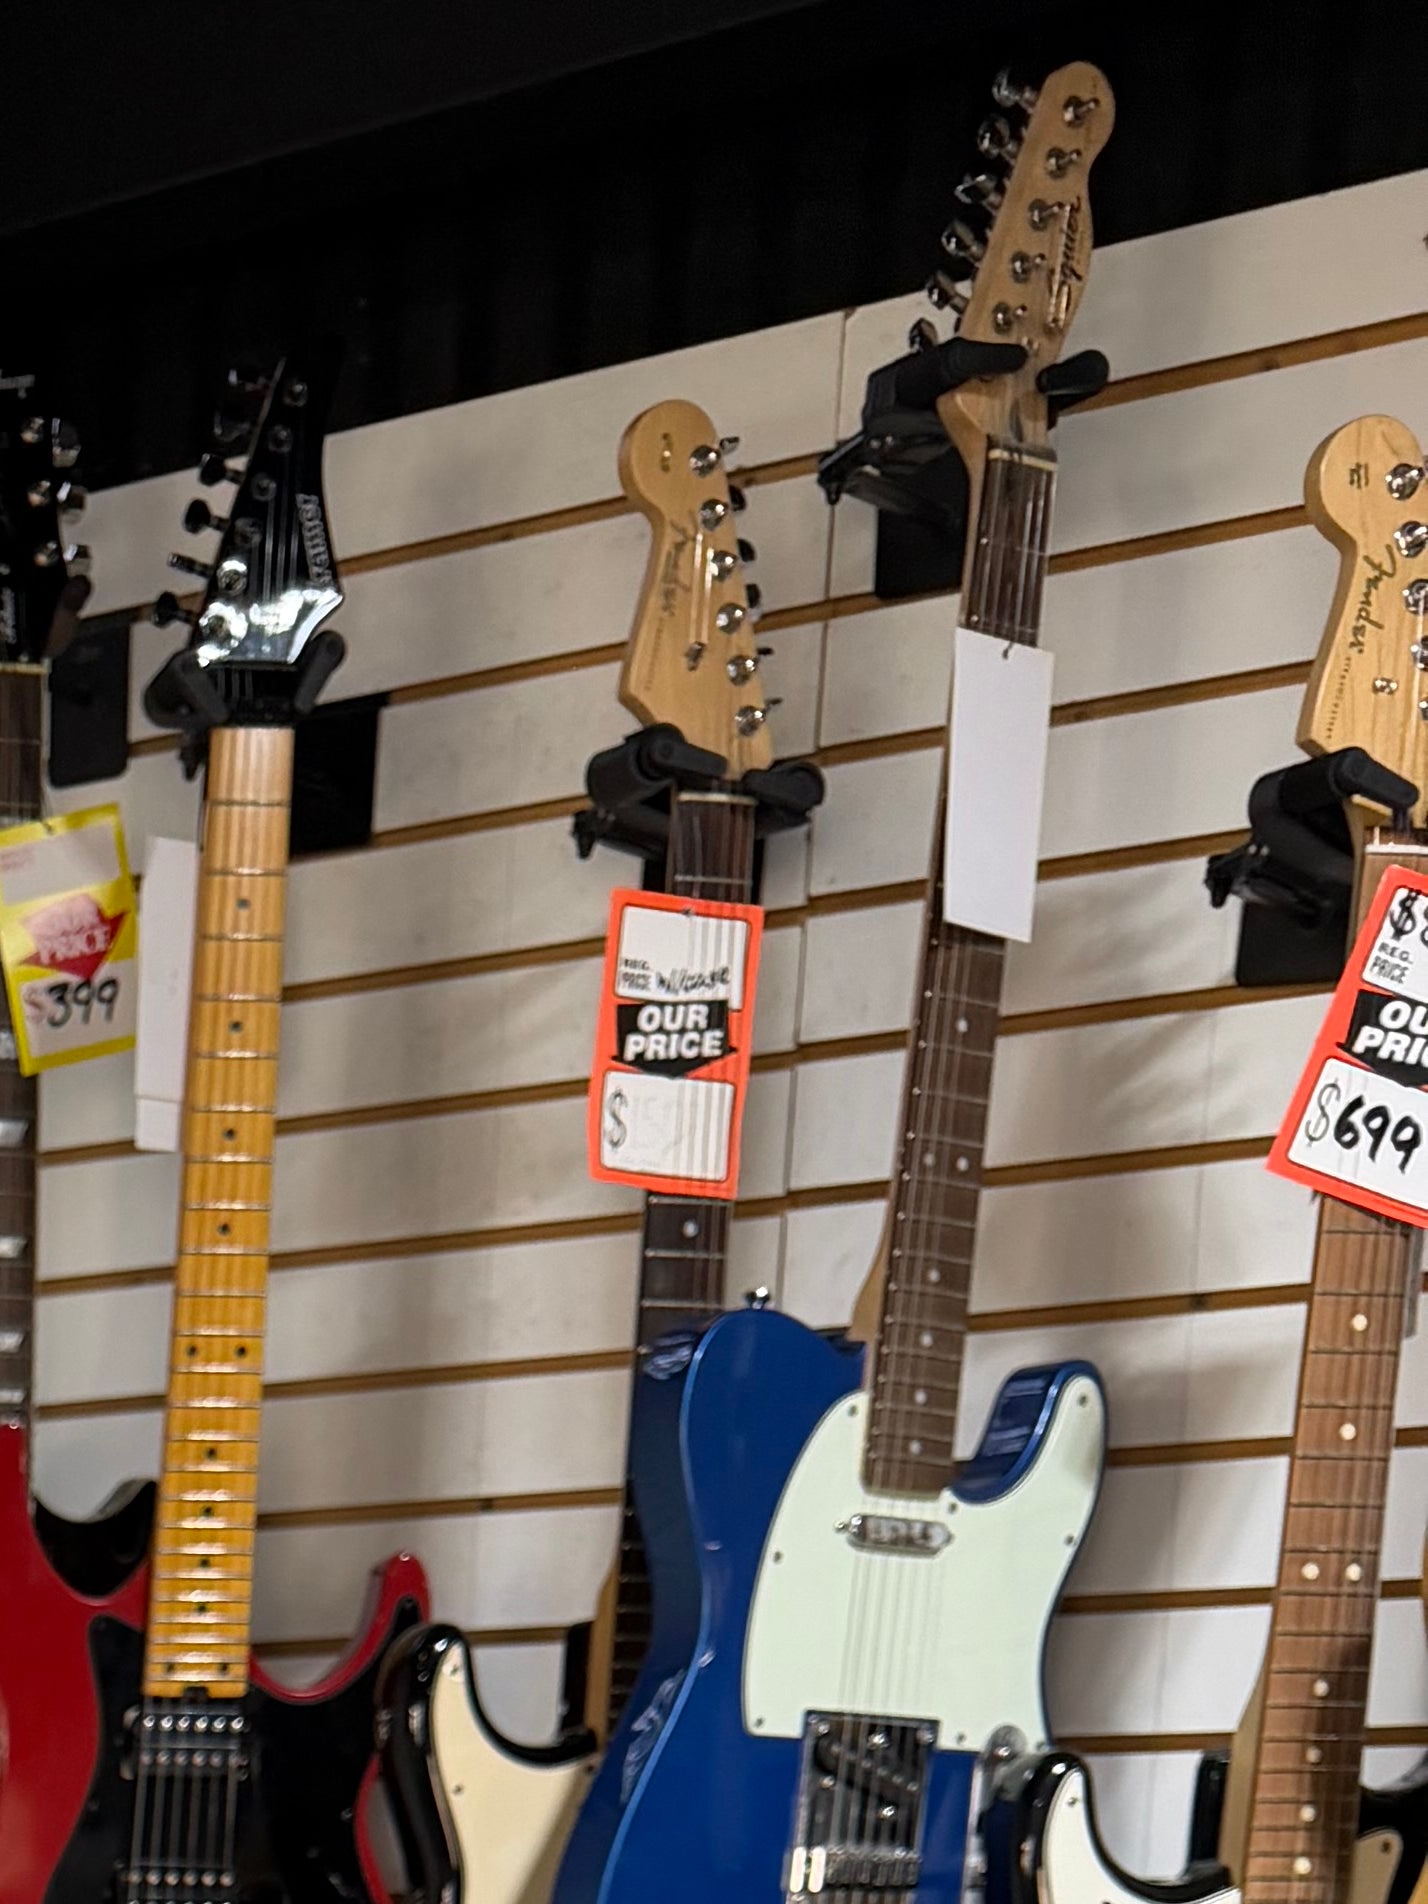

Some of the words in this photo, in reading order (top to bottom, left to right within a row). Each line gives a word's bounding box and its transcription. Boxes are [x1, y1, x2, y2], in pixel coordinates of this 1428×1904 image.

[1348, 543, 1397, 656] Fender
[637, 1004, 709, 1032] OUR
[1378, 1000, 1428, 1035] OU
[622, 1031, 725, 1062] PRICE
[1351, 1025, 1428, 1067] PRI
[1305, 1076, 1422, 1176] $699
